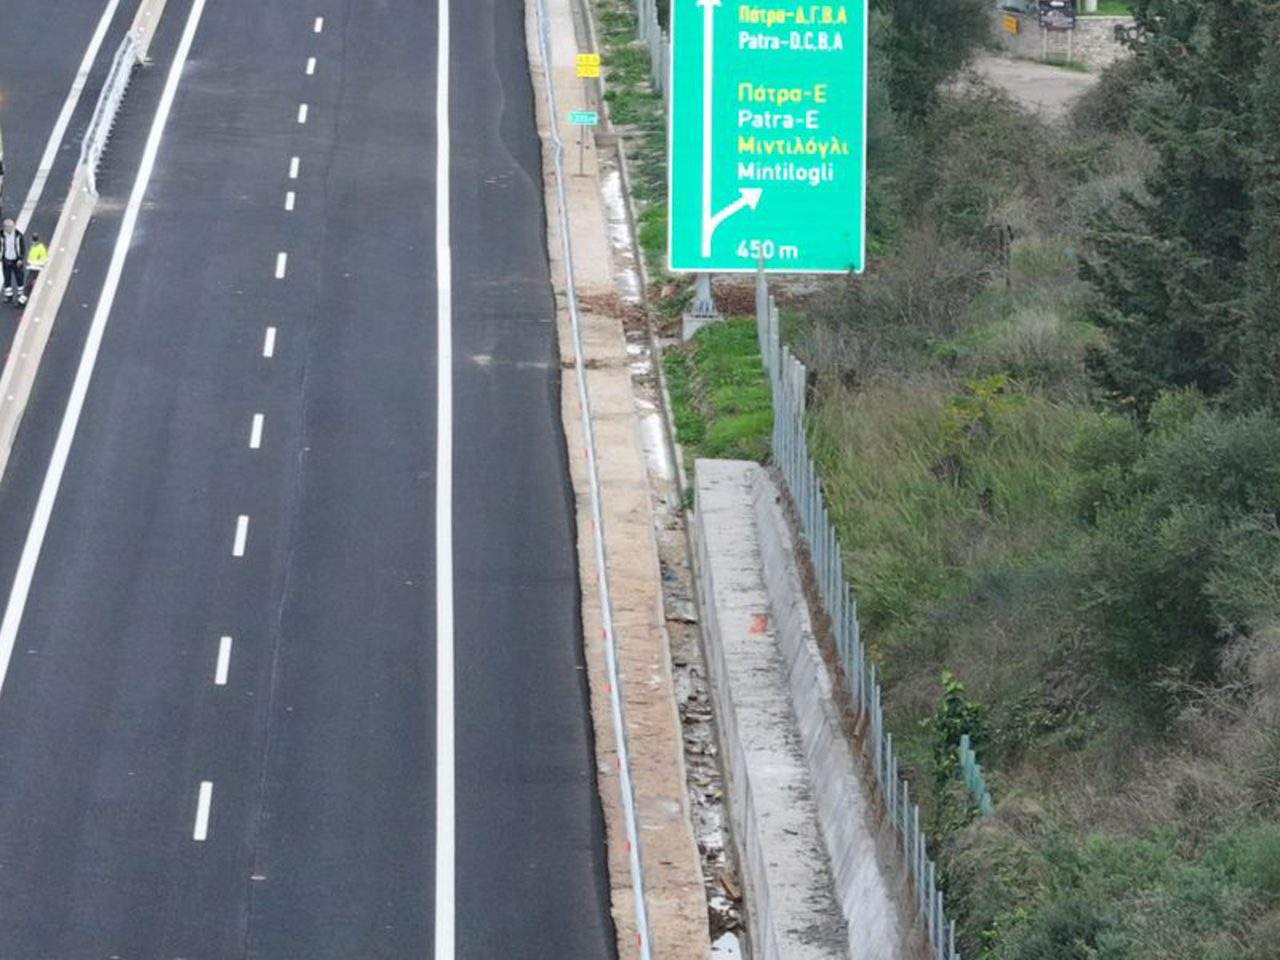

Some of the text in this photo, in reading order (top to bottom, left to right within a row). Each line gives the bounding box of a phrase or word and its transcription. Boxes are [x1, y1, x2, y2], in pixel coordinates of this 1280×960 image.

[739, 31, 843, 50] Patra-D.C.B.A
[738, 82, 827, 106] Πάτρα-Ε
[738, 109, 819, 129] Patra-E
[738, 136, 849, 158] Μιντιλόγλι
[738, 162, 834, 186] Mintilogli
[737, 240, 799, 258] 450 m
